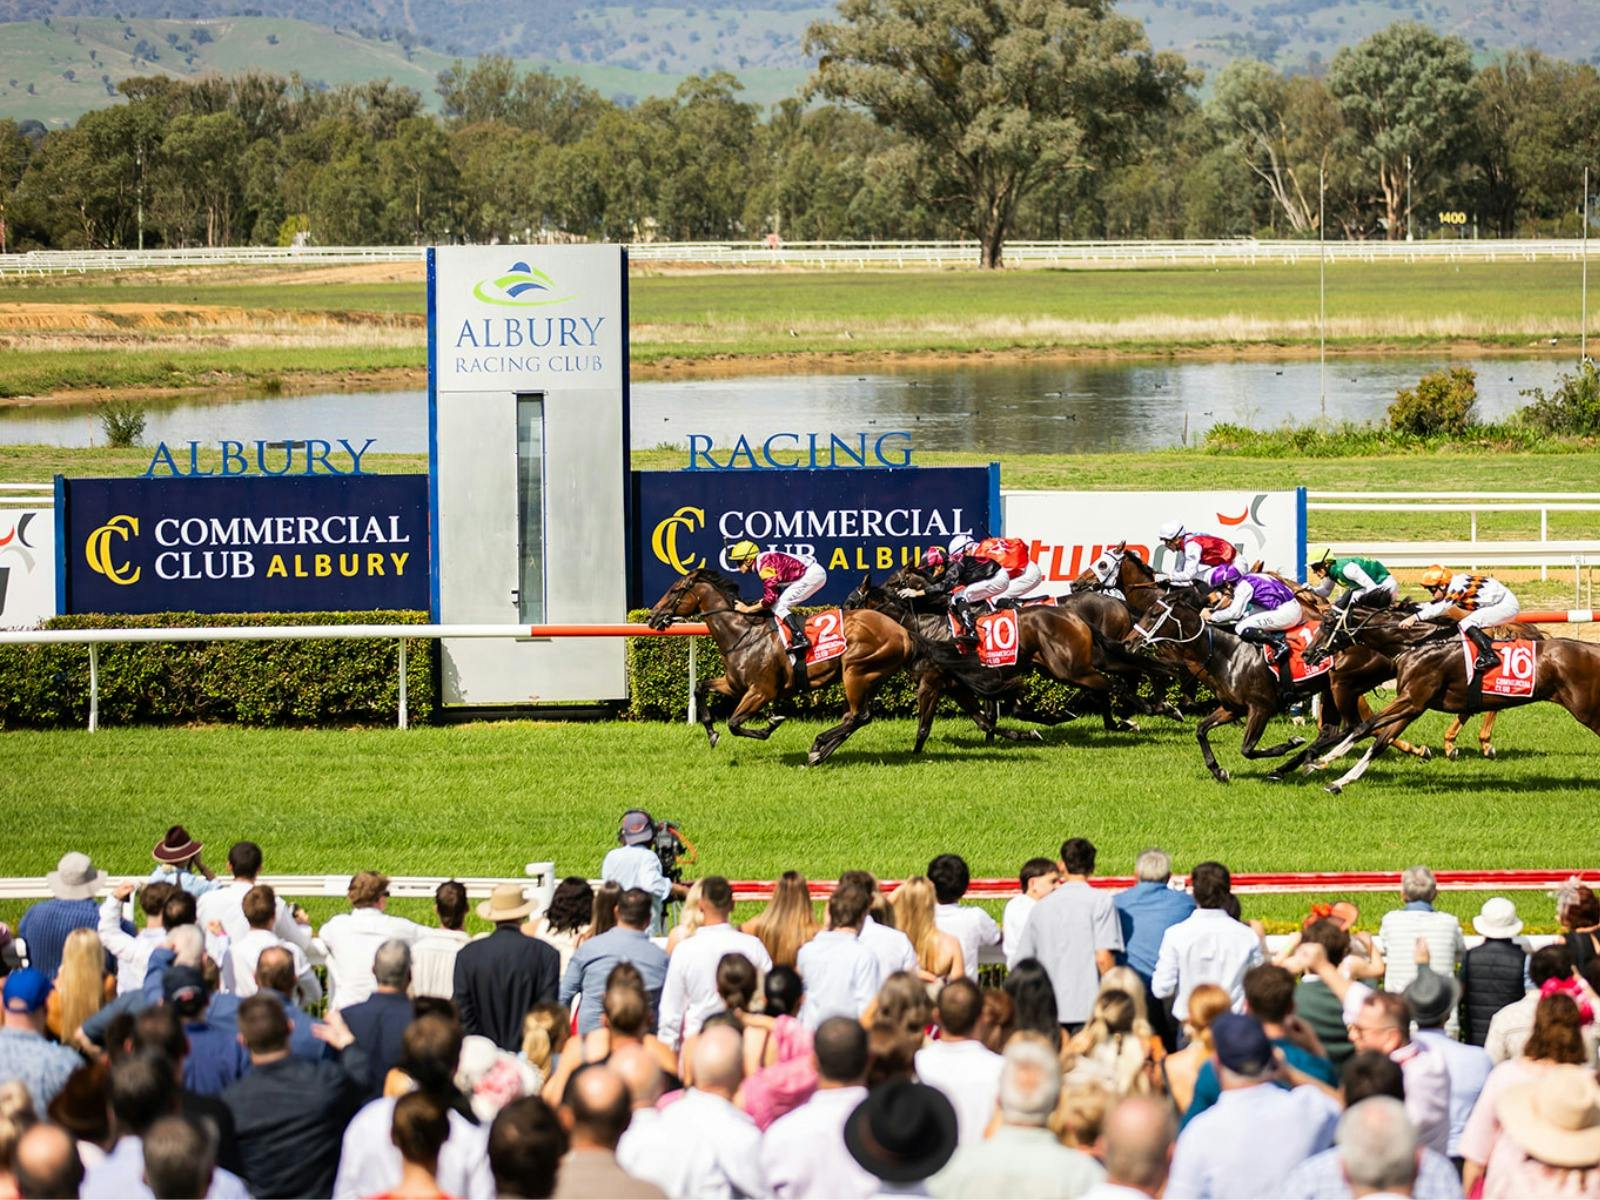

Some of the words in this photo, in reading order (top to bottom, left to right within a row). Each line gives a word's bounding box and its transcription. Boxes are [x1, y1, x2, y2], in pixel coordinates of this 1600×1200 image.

[1439, 211, 1467, 224] 1400
[455, 317, 606, 348] ALBURY
[456, 356, 541, 373] RACING
[549, 355, 603, 372] CLUB
[145, 438, 378, 476] ALBURY
[683, 430, 916, 470] RACING
[155, 515, 410, 547] COMMERCIAL
[718, 508, 974, 540] COMMERCIAL
[155, 551, 256, 580] CLUB
[266, 552, 410, 578] ALBURY
[828, 546, 947, 570] ALBU
[814, 614, 837, 643] 2
[982, 616, 1015, 650] 10
[1500, 646, 1533, 679] 16
